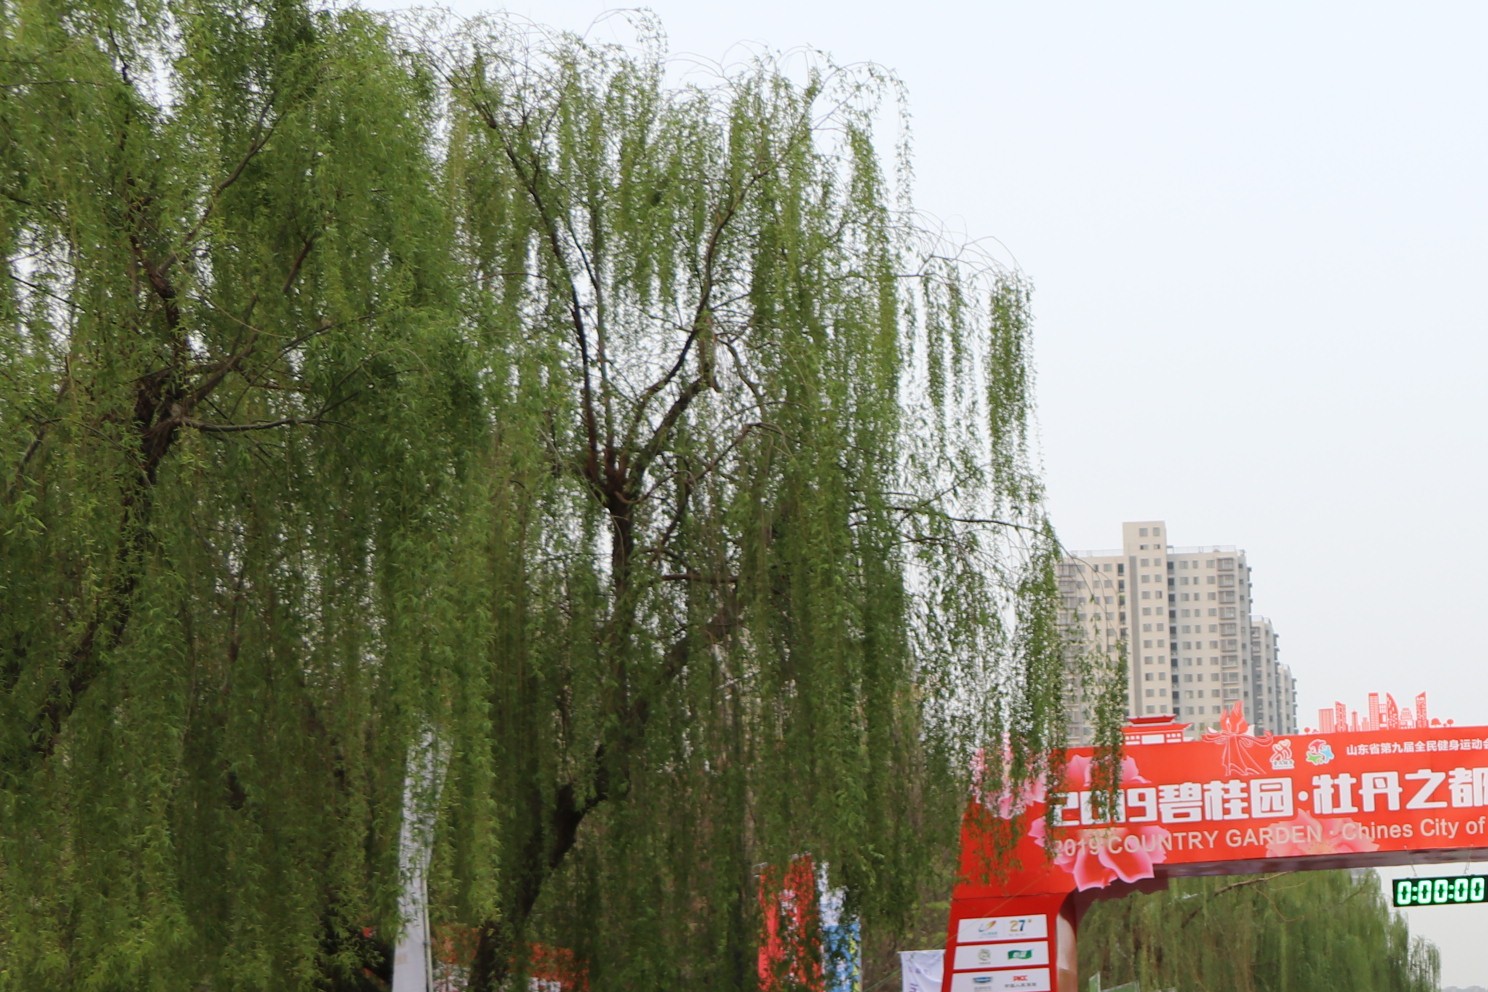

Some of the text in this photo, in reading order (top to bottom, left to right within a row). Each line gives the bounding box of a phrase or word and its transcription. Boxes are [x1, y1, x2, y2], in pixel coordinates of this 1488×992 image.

[1108, 830, 1218, 854] COUNTRY
[1225, 825, 1323, 847] GARDEN
[1341, 822, 1413, 841] Chines
[1420, 817, 1459, 839] City
[1465, 816, 1486, 835] of
[1397, 877, 1485, 906] 0:00:00
